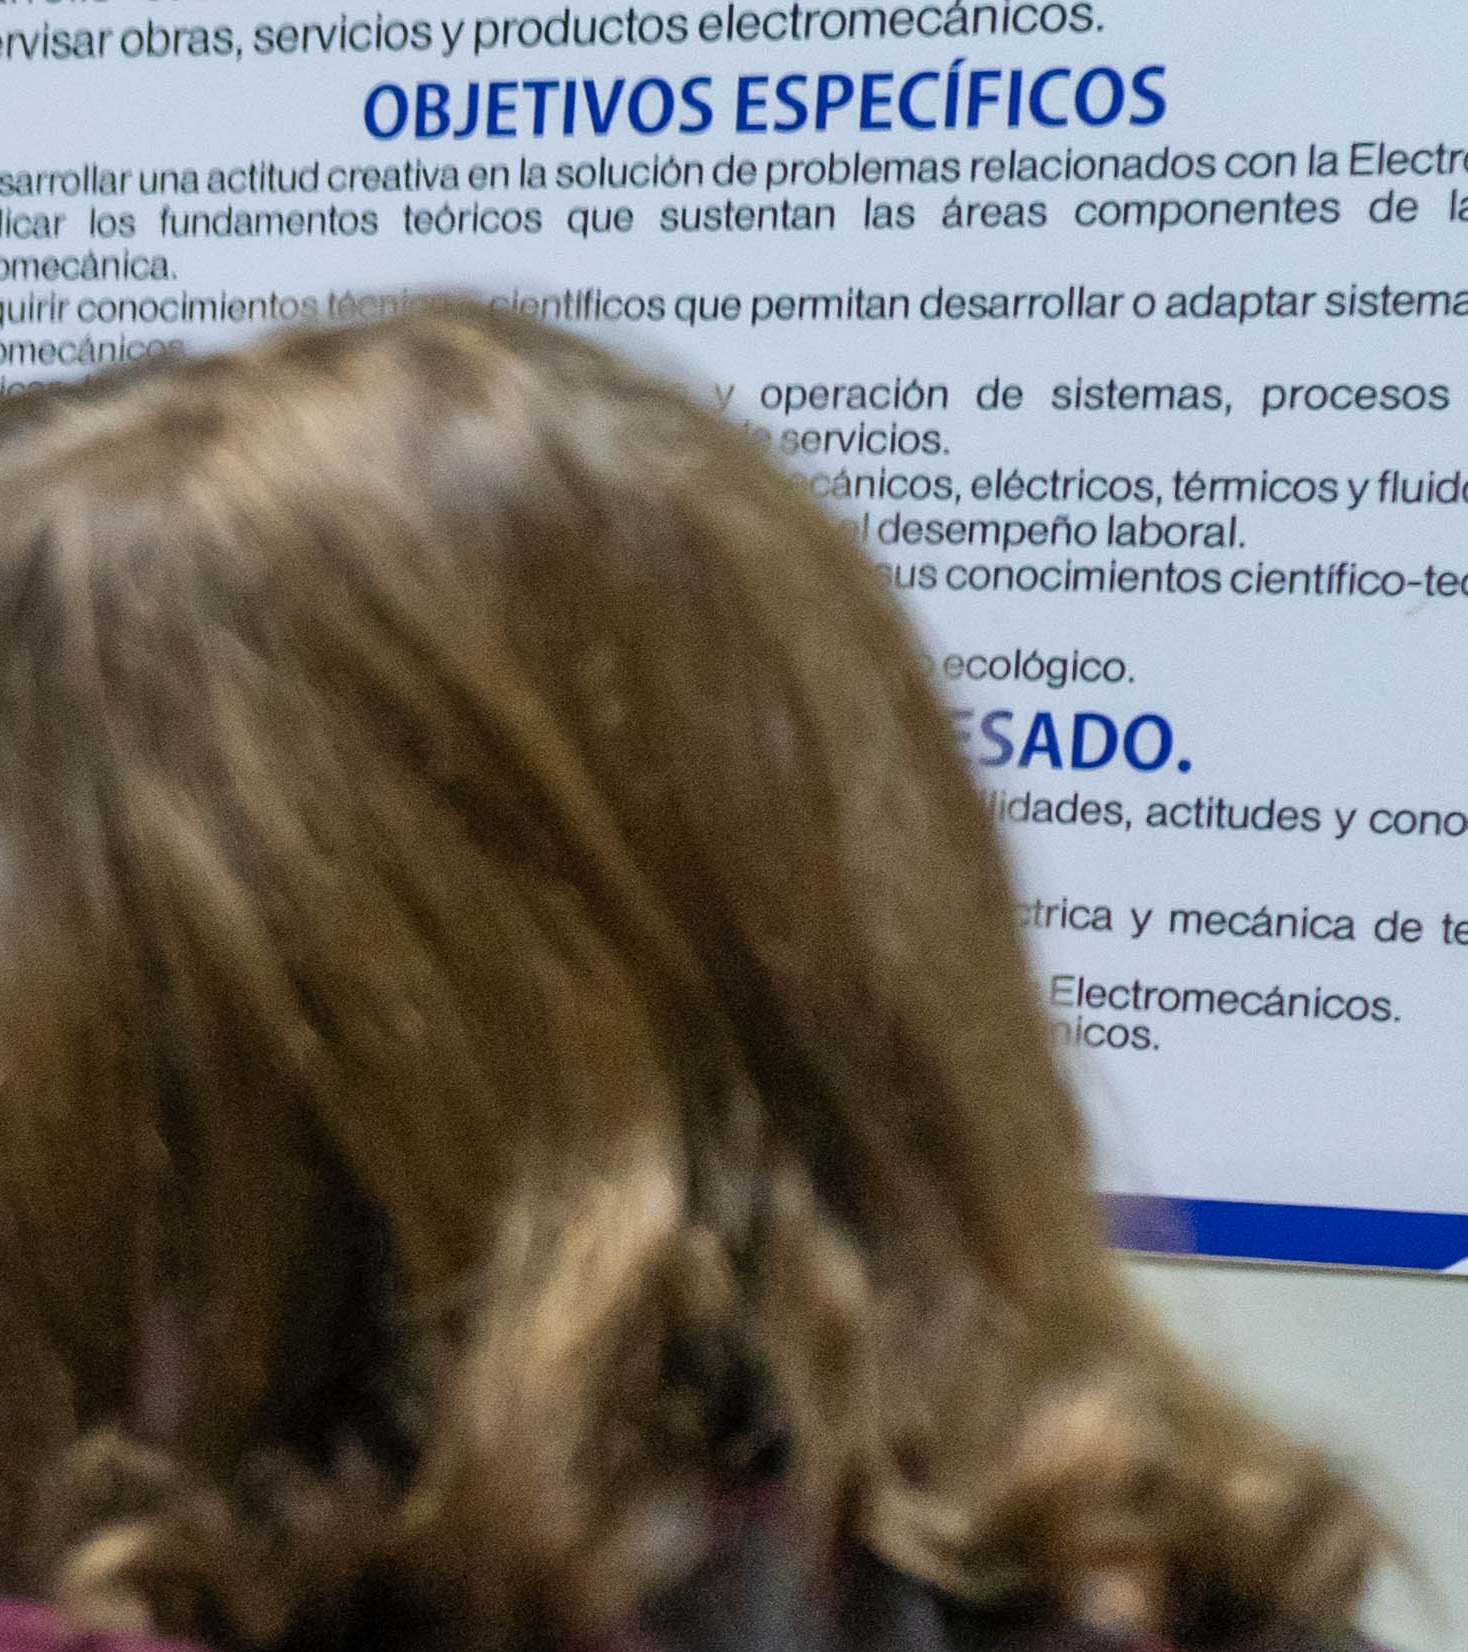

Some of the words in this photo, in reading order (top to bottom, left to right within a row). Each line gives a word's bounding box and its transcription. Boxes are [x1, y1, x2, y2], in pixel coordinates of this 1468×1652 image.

[120, 18, 244, 63] obras,
[253, 13, 433, 56] servicios
[441, 20, 467, 57] y
[474, 6, 690, 54] productos
[697, 0, 1105, 44] electromecánicos.
[363, 74, 715, 143] OBJETIVOS
[735, 59, 1168, 134] ESPECÍFICOS
[139, 170, 200, 197] una
[206, 161, 321, 195] actitud
[327, 159, 461, 194] creativa
[468, 166, 512, 192] en
[519, 159, 551, 191] la
[556, 152, 704, 192] solución
[713, 152, 758, 187] de
[765, 152, 961, 195] problemas
[970, 147, 1217, 185] relacionados
[1225, 151, 1297, 179] con
[1308, 143, 1339, 177] la
[1349, 141, 1468, 177] Electr
[89, 207, 136, 240] los
[160, 204, 379, 238] fundamentos
[403, 202, 542, 237] teóricos
[567, 206, 635, 242] que
[660, 199, 836, 232] sustentan
[864, 196, 915, 230] las
[941, 194, 1048, 229] áreas
[1075, 190, 1341, 232] componentes
[1369, 189, 1419, 224] de
[77, 289, 319, 326] conocimientos
[675, 294, 742, 328] que
[751, 287, 911, 326] permitan
[919, 285, 1124, 321] desarrollar
[1133, 294, 1157, 320] o
[1165, 283, 1317, 325] adaptar
[1325, 282, 1468, 317] sistema
[714, 382, 735, 413] y
[760, 375, 949, 416] operación
[976, 375, 1024, 411] de
[1051, 376, 1233, 418] sistemas,
[1262, 380, 1451, 418] procesos
[780, 421, 950, 456] servicios.
[970, 467, 1163, 508] eléctricos,
[1172, 468, 1339, 504] térmicos
[1348, 477, 1370, 510] y
[1378, 468, 1468, 504] fluid
[877, 512, 1097, 553] desempeño
[1106, 514, 1246, 550] laboral.
[945, 559, 1222, 597] conocimientos
[943, 648, 1135, 689] ecológico.
[1145, 796, 1322, 834] actitudes
[1334, 807, 1358, 841] y
[1130, 906, 1153, 939] y
[1169, 904, 1356, 942] mecánica
[1374, 909, 1424, 943] de
[1050, 974, 1402, 1024] Electromecánicos.
